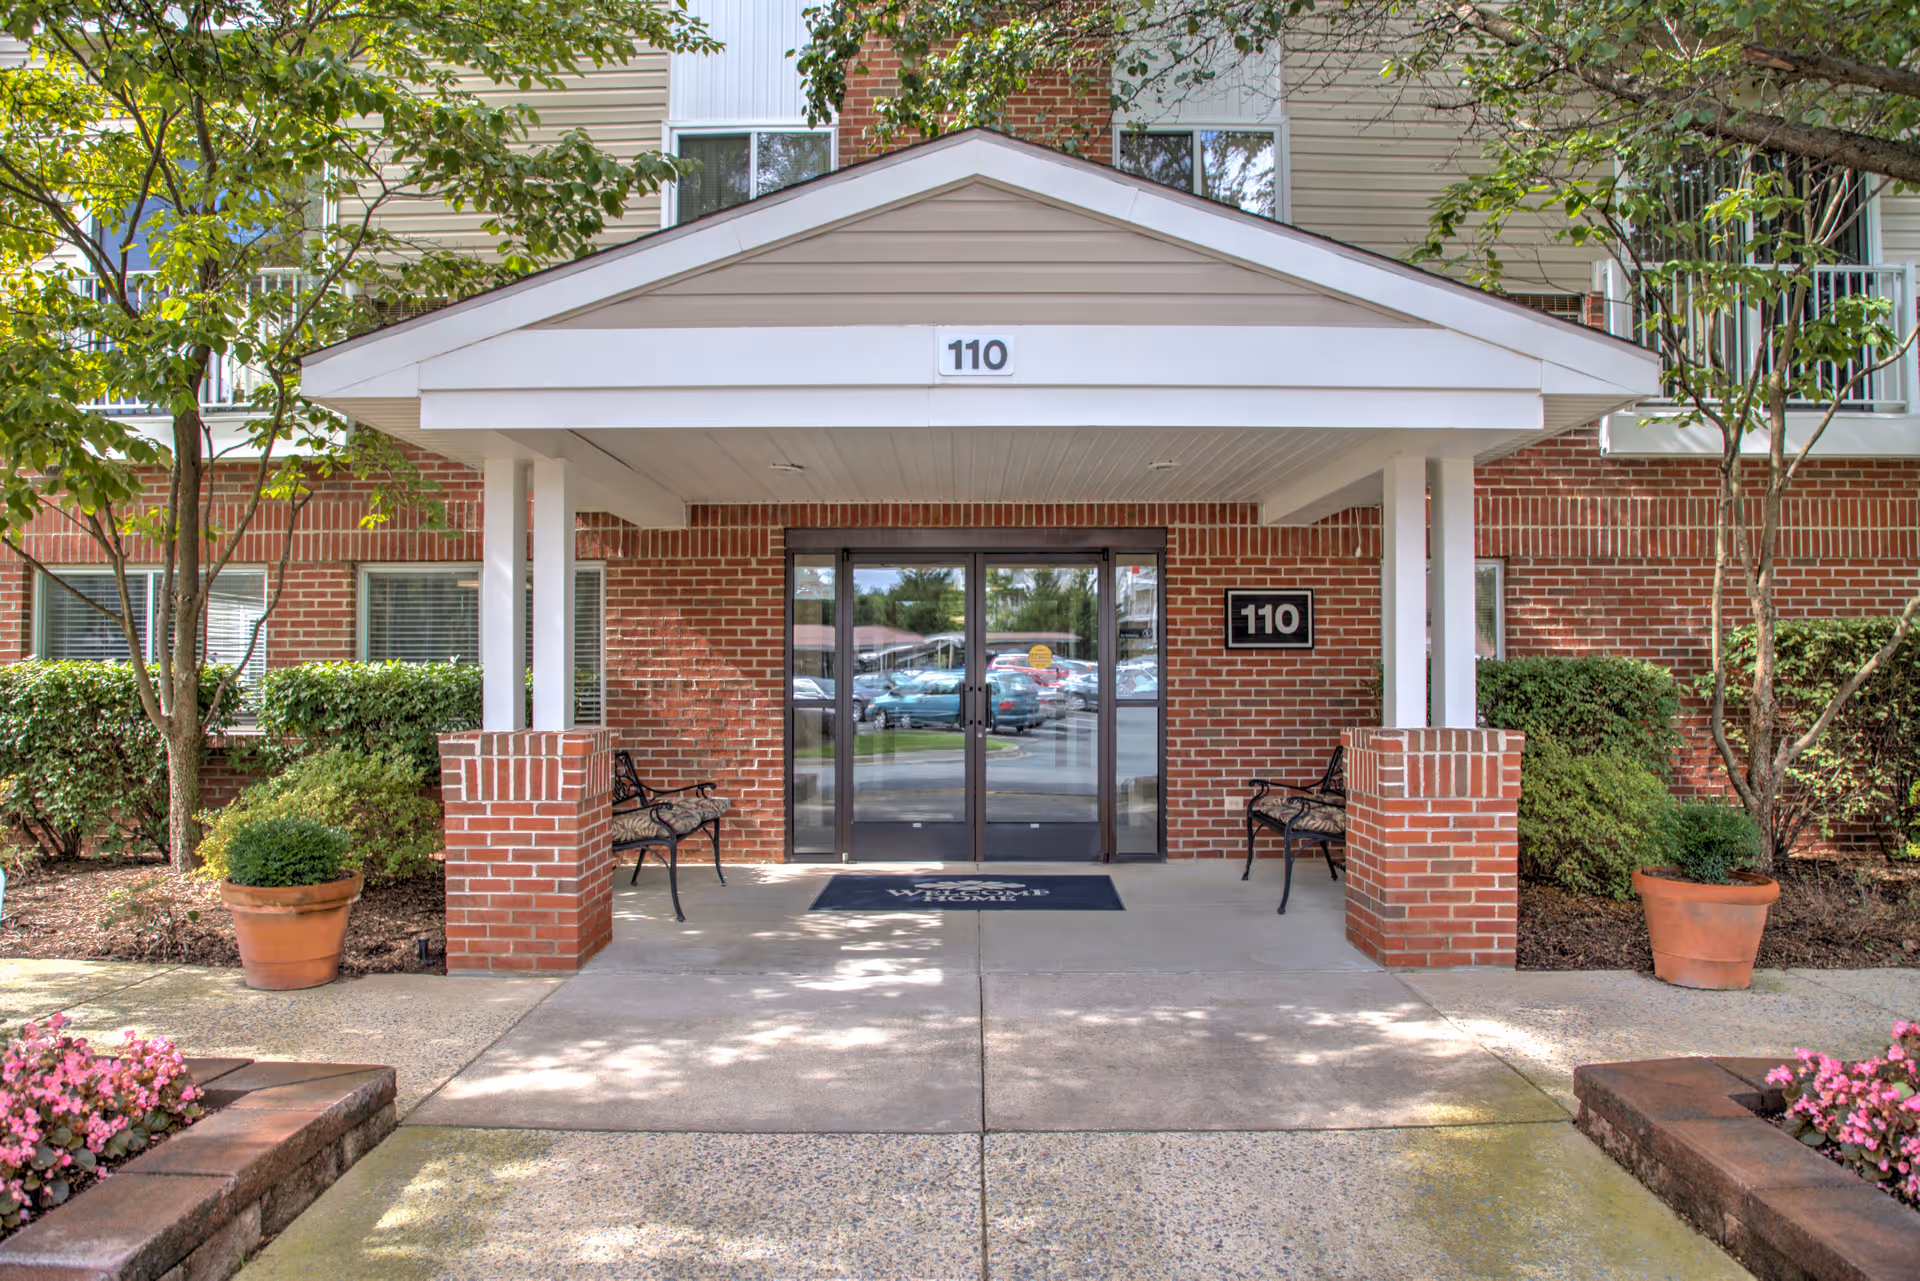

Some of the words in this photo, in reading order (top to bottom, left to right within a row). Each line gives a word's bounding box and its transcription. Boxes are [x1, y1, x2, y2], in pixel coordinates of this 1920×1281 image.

[948, 339, 1008, 370] 110
[1241, 603, 1300, 635] 110
[886, 888, 1050, 897] WELCOME
